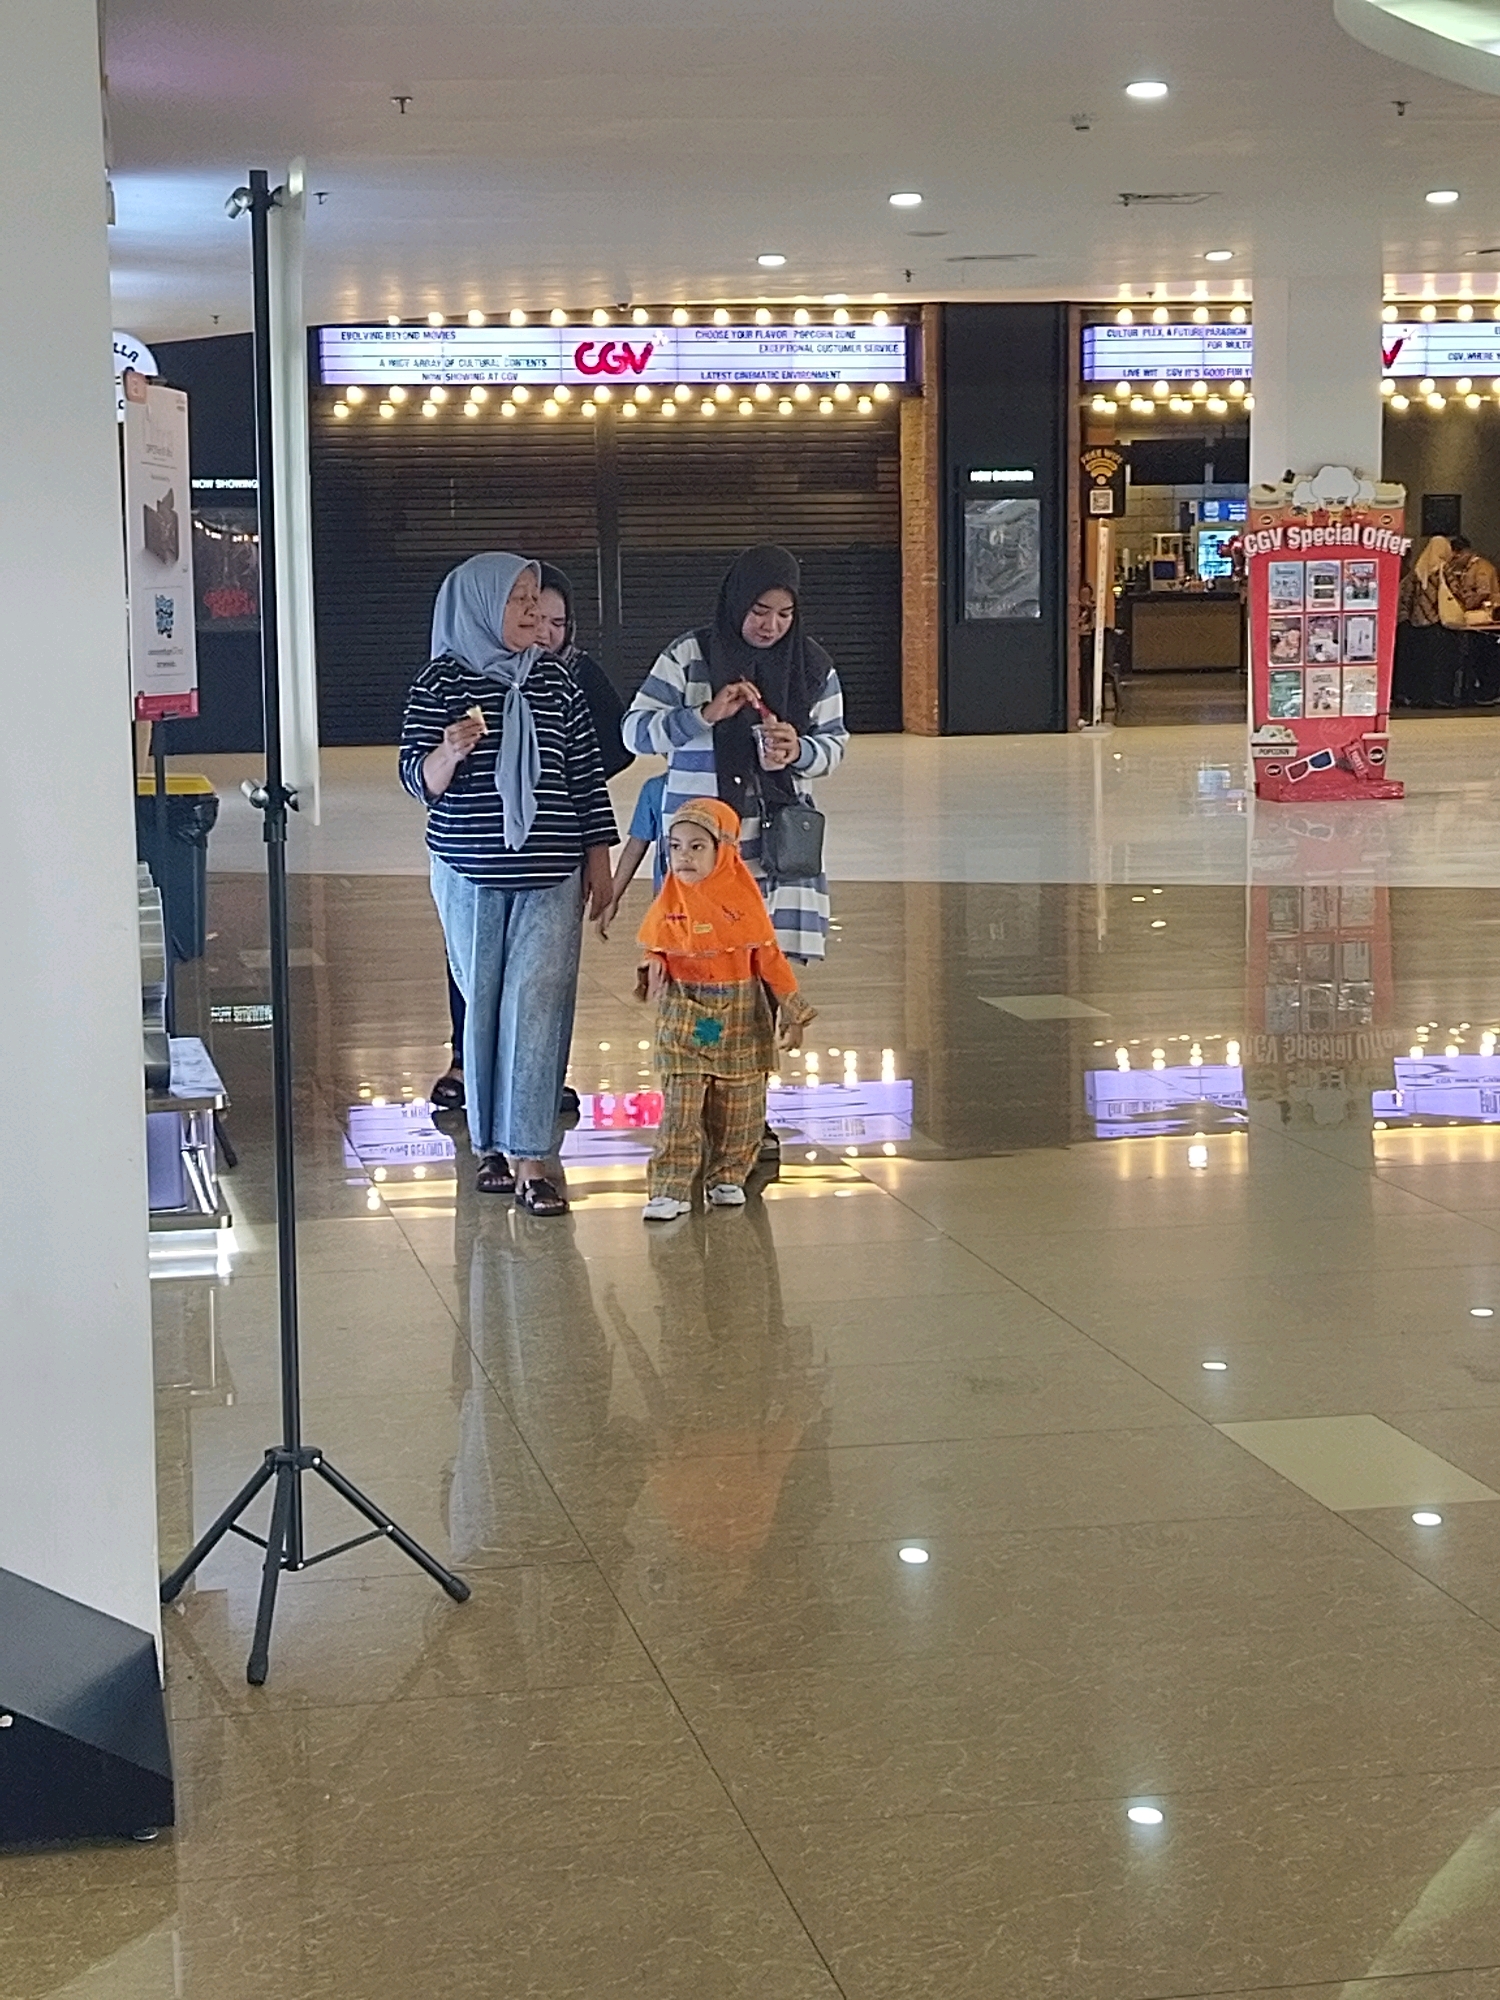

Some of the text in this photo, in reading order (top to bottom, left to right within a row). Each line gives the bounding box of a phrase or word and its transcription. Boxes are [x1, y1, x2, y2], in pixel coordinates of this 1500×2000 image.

[341, 330, 456, 340] EVOLVING BEYOND MOVIES
[695, 330, 729, 339] CHOOSE
[732, 330, 753, 339] YOUR
[755, 330, 788, 339] FLAVOR
[835, 330, 856, 339] ZONE
[1173, 328, 1203, 337] FUTURE
[1205, 327, 1247, 337] PARADIGM
[759, 344, 899, 353] EXCEPTIONAL CUSTOMER SERVICE
[1207, 341, 1223, 349] FOR
[574, 341, 654, 375] CGV
[379, 359, 385, 368] A
[413, 359, 441, 368] ARRAY
[444, 359, 455, 368] OF
[458, 359, 500, 368] CULTURAL
[504, 359, 547, 368] CONTENTS
[422, 372, 518, 381] NOW SHOWING AT CGV
[700, 370, 842, 380] LATEST CINEMATIC ENVIRONMENT
[1123, 369, 1140, 378] LIVE
[1166, 368, 1183, 377] CGV
[1203, 368, 1225, 377] GOOD
[1227, 368, 1242, 377] FOR
[192, 479, 214, 489] NOW
[1244, 523, 1412, 556] CGV Special Offer
